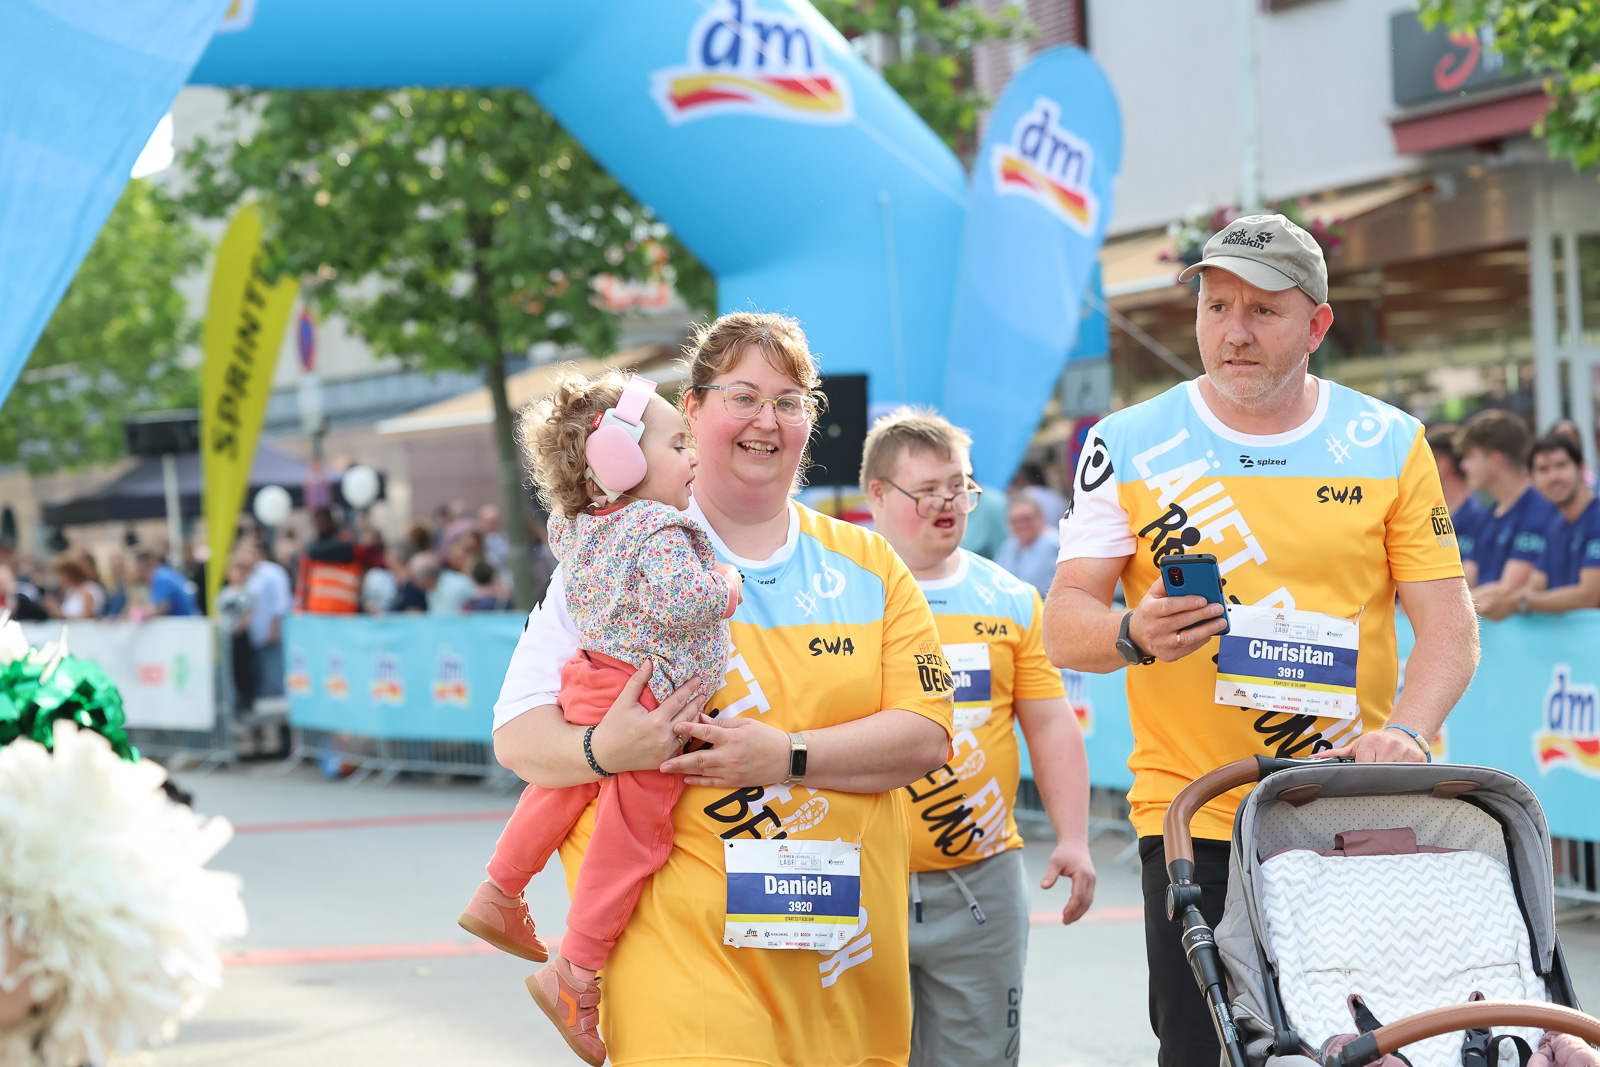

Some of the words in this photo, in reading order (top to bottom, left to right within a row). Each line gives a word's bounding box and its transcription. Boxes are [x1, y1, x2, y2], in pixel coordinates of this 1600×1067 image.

[702, 0, 813, 67] dm
[1020, 109, 1085, 184] dm
[1221, 236, 1265, 250] Wolfskin
[1257, 458, 1287, 467] spized
[1316, 485, 1363, 505] SWA
[974, 621, 1008, 636] SWA
[808, 636, 855, 657] SWA
[1248, 639, 1334, 667] Chrisitan
[1277, 667, 1305, 679] 3919
[1549, 673, 1594, 734] dm
[764, 875, 832, 896] Daniela
[788, 901, 813, 912] 3920
